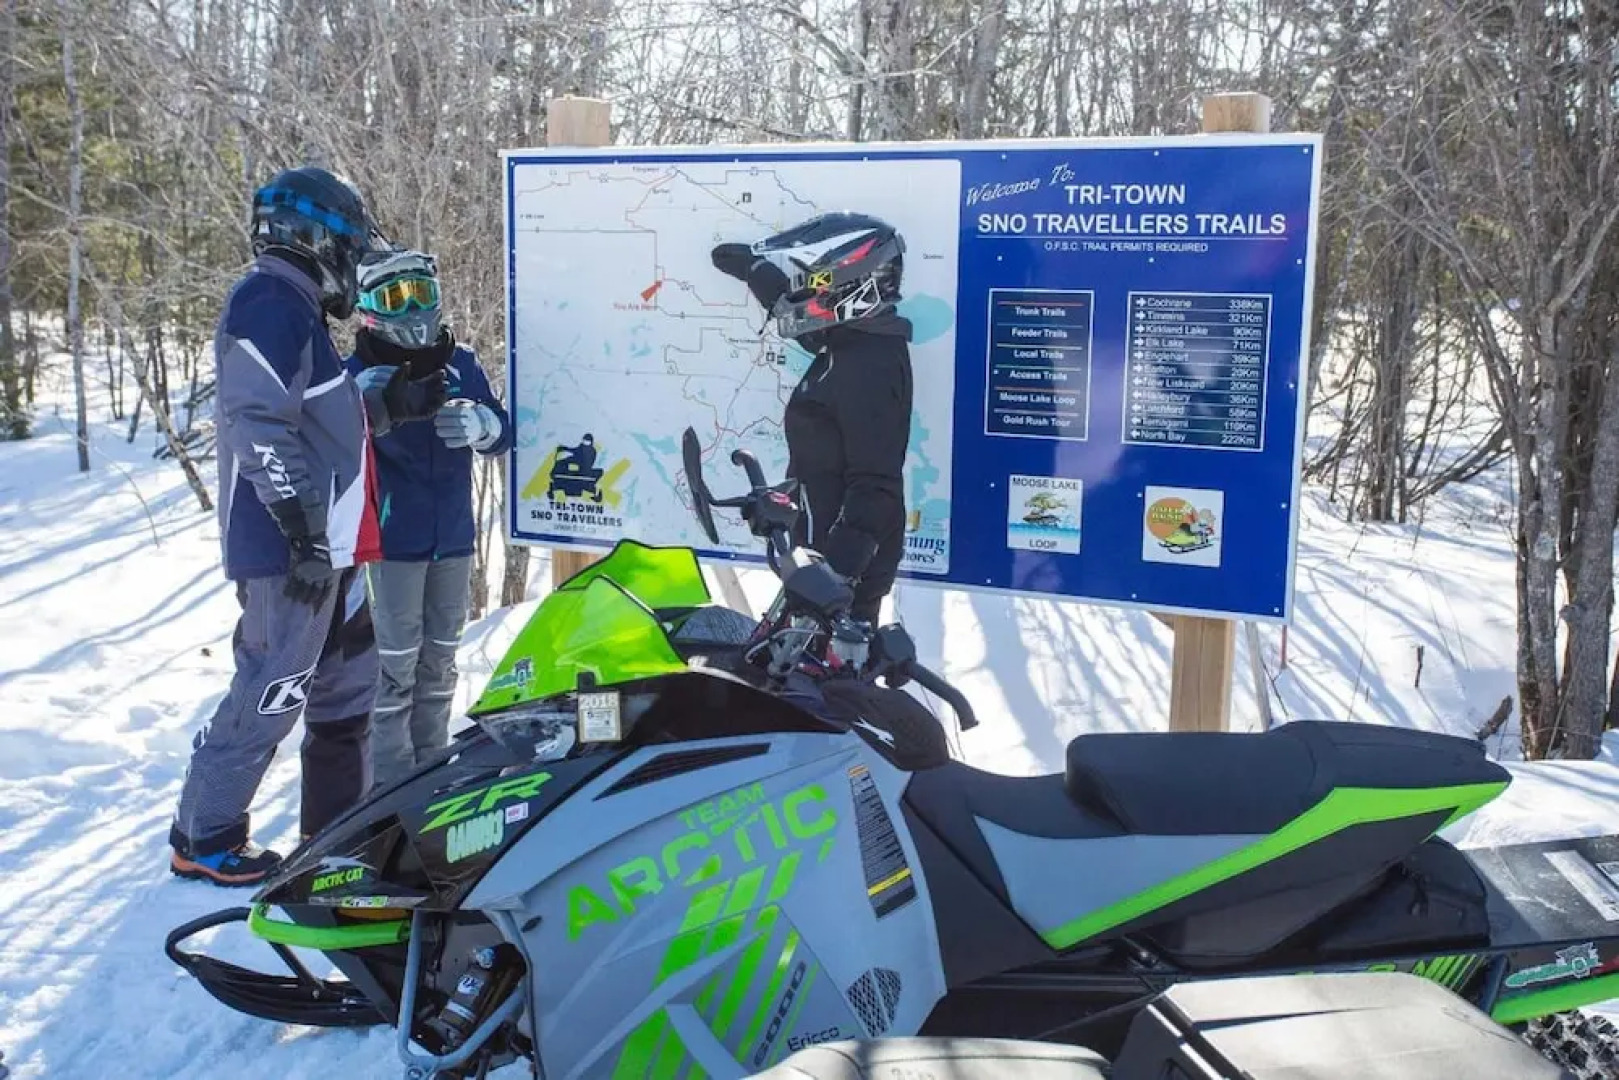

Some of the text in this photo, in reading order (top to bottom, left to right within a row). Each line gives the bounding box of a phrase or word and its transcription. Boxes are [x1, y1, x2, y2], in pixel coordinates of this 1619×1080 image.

[966, 178, 1040, 206] Welcome
[1064, 184, 1186, 205] TRI-TOWN
[978, 213, 1286, 235] SNO TRAVELLERS TRAILS
[1082, 241, 1109, 252] TRAIL
[1110, 241, 1153, 252] PERMITS
[1155, 242, 1208, 253] REQUIRED
[1147, 298, 1192, 308] Cochrane
[1014, 306, 1066, 317] Trunk Trails
[1146, 311, 1263, 323] Timmins 321Km
[1011, 327, 1068, 338] Feeder Trails
[1145, 324, 1183, 334] Kirkland
[1184, 325, 1208, 335] Lake
[1161, 338, 1186, 348] Lake
[1232, 341, 1261, 351] 71Km
[1013, 350, 1065, 360] Local Trails
[1009, 370, 1067, 381] Access Trails
[1230, 381, 1258, 391] 20Km
[999, 392, 1076, 406] Moose Lake Loop
[1003, 415, 1071, 427] Gold Rush Tour
[1140, 430, 1166, 440] North
[1168, 431, 1186, 443] Bay
[1012, 476, 1079, 491] MOOSE LAKE
[549, 501, 604, 514] TRI-TOWN
[530, 509, 623, 527] SNO TRAVELLERS
[1028, 538, 1058, 549] LOOP
[418, 772, 553, 834] ZR
[678, 782, 766, 830] TEAM
[565, 784, 838, 943] ARCTIC
[311, 867, 365, 892] ARCTIC CAT
